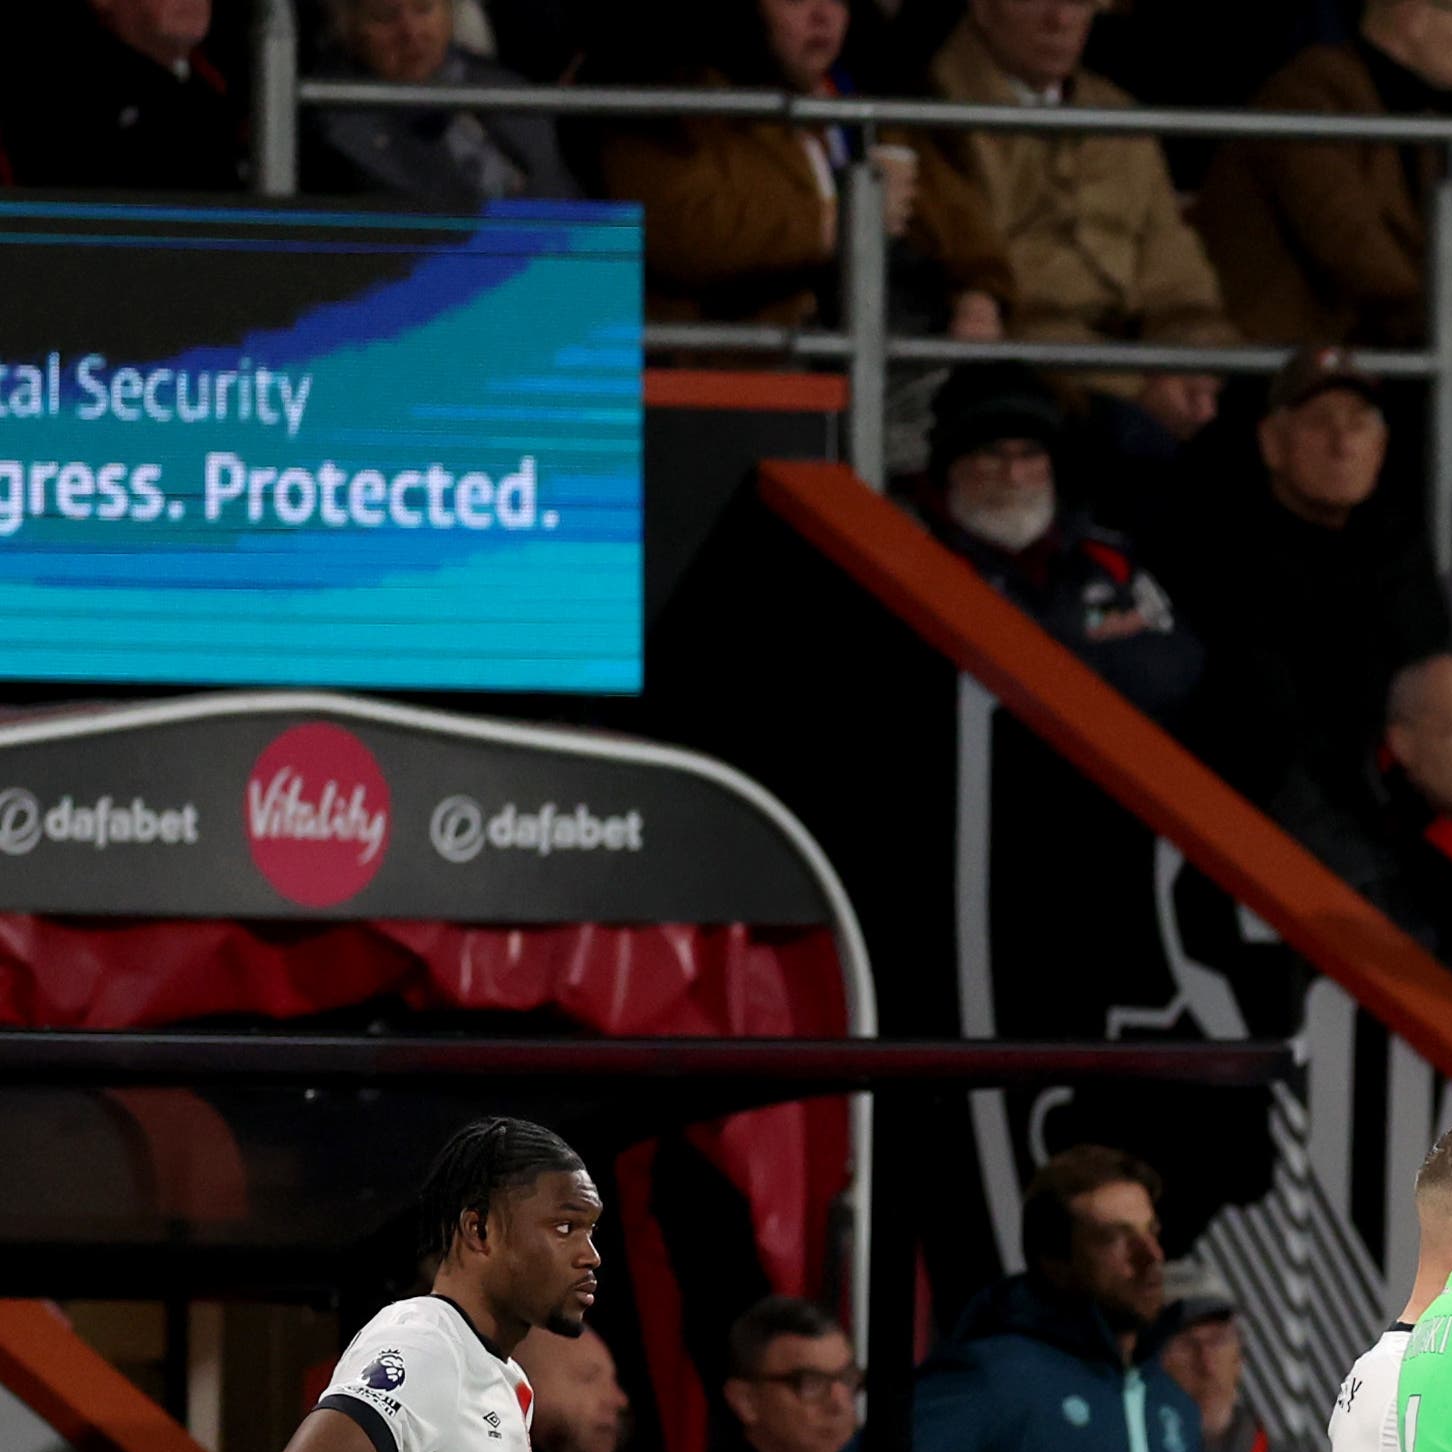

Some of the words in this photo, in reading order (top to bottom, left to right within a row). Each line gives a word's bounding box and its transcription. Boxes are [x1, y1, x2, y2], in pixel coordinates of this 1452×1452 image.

[77, 354, 312, 438] Security
[0, 459, 184, 535] gress.
[205, 453, 560, 529] Protected.
[45, 798, 199, 848] dafabet
[248, 766, 388, 862] Vitality
[487, 803, 643, 857] dafabet
